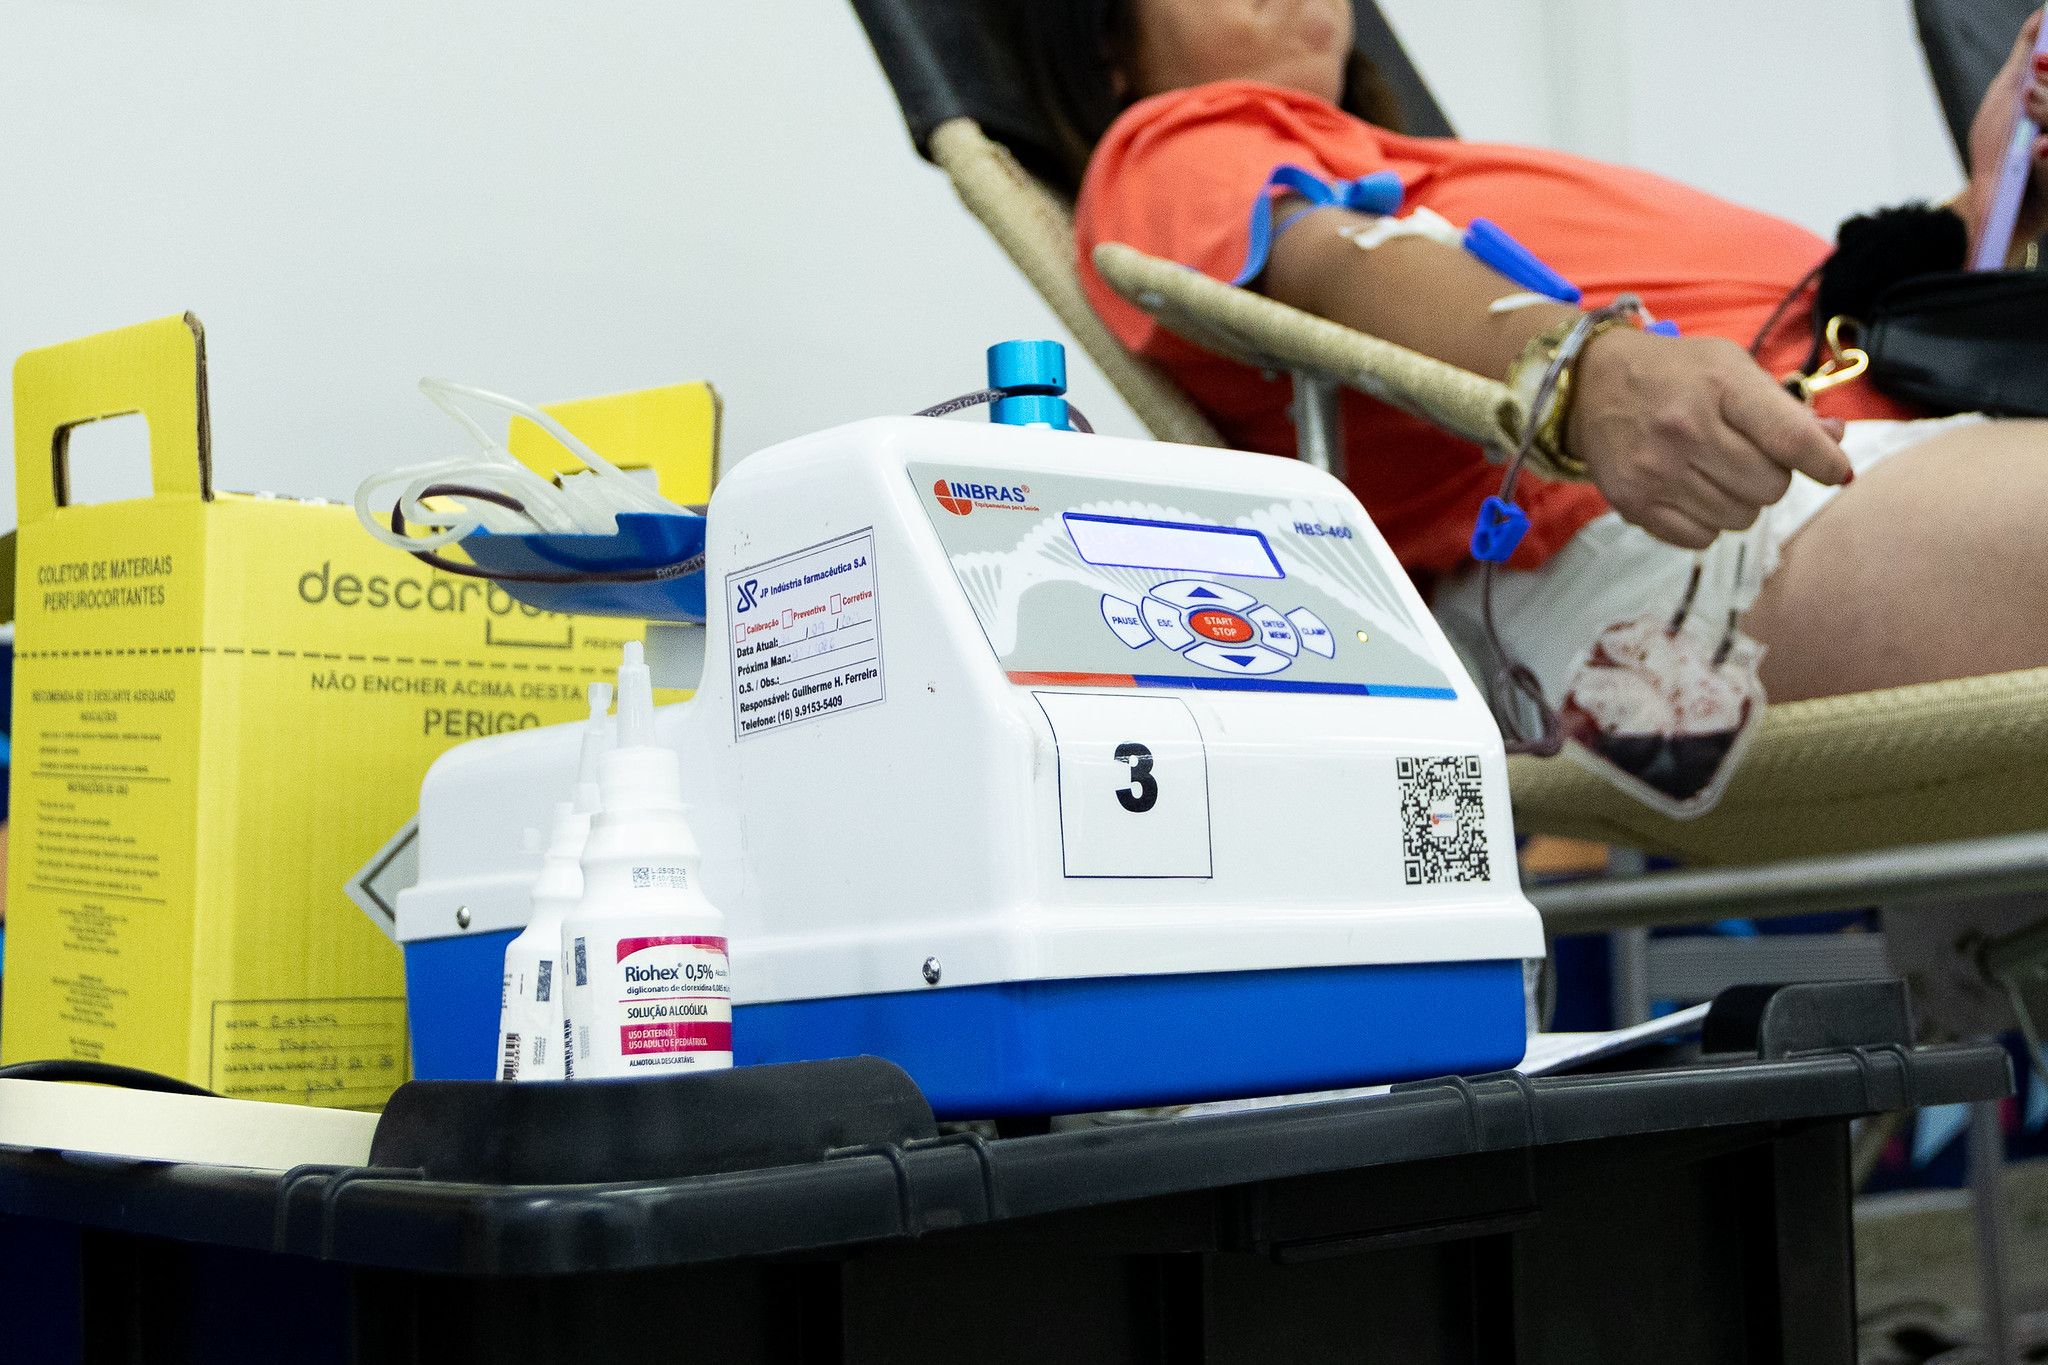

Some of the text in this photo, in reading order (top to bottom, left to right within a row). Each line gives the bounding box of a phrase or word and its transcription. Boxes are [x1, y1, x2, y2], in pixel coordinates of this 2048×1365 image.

[1293, 521, 1353, 539] HBS-460
[37, 554, 173, 585] COLETOR DE MATERIAIS
[760, 556, 867, 599] JP Indústria farmacêutica S.A
[43, 583, 166, 611] PERFUROCORTANTES
[746, 618, 779, 635] Calibração
[793, 604, 827, 621] Preventiva
[842, 590, 873, 606] Corretiva
[1112, 616, 1139, 626] PAUSE
[1204, 616, 1233, 626] START
[1157, 618, 1174, 628] ESC
[1212, 626, 1238, 637] STOP
[1262, 620, 1286, 628] ENTER
[1302, 627, 1326, 636] CLAMP
[1269, 630, 1291, 640] MEMO
[737, 645, 754, 658] Data
[756, 637, 779, 653] Atual:
[738, 660, 769, 677] Próxima
[311, 669, 582, 701] NÃO ENCHER ACIMA DESTA
[739, 682, 754, 695] O.S.
[740, 667, 878, 713] Responsável: Guilherme H. Ferreira
[741, 695, 843, 731] Telefone: (16) 9.9153-5409
[1114, 742, 1159, 814] 3
[685, 963, 714, 982] 0,5%
[627, 984, 670, 996] digliconato
[670, 983, 680, 992] de
[627, 1003, 708, 1020] SOLUÇÃO ALCOÓLICA
[628, 1030, 642, 1040] USO
[629, 1040, 642, 1050] USO
[643, 1038, 669, 1048] ADULTO
[629, 1055, 695, 1067] ALMOTOLIA DESCARTÁVEL
